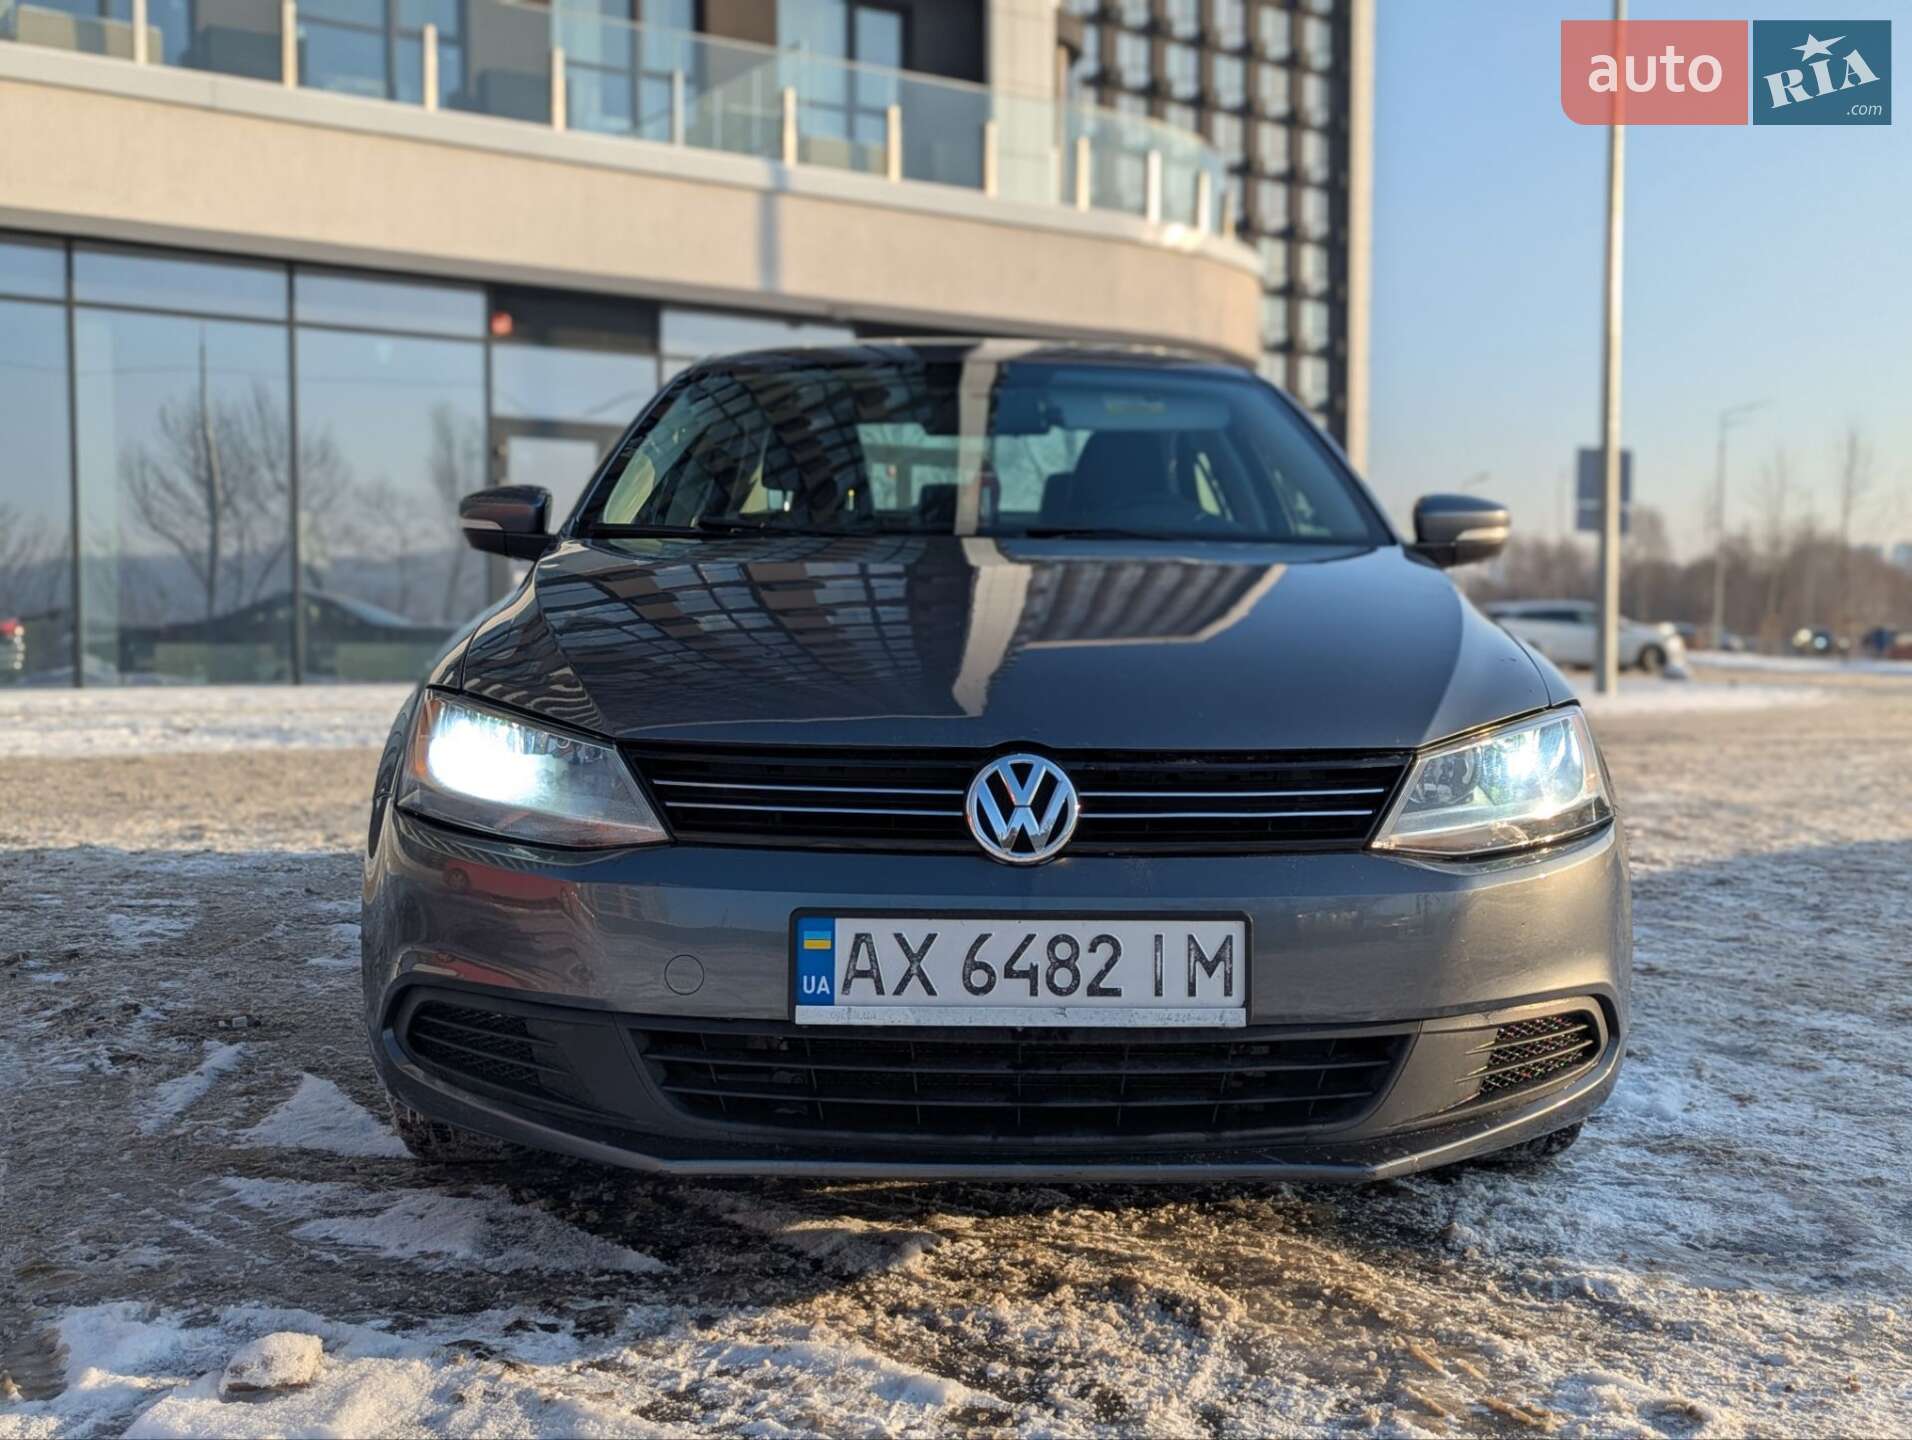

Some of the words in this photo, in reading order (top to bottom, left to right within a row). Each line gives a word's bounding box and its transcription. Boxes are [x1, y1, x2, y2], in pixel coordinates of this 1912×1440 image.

[968, 754, 1079, 862] VW
[803, 975, 830, 994] UA
[841, 933, 937, 996] AX
[962, 933, 1122, 996] 6482
[1154, 934, 1233, 997] IM
